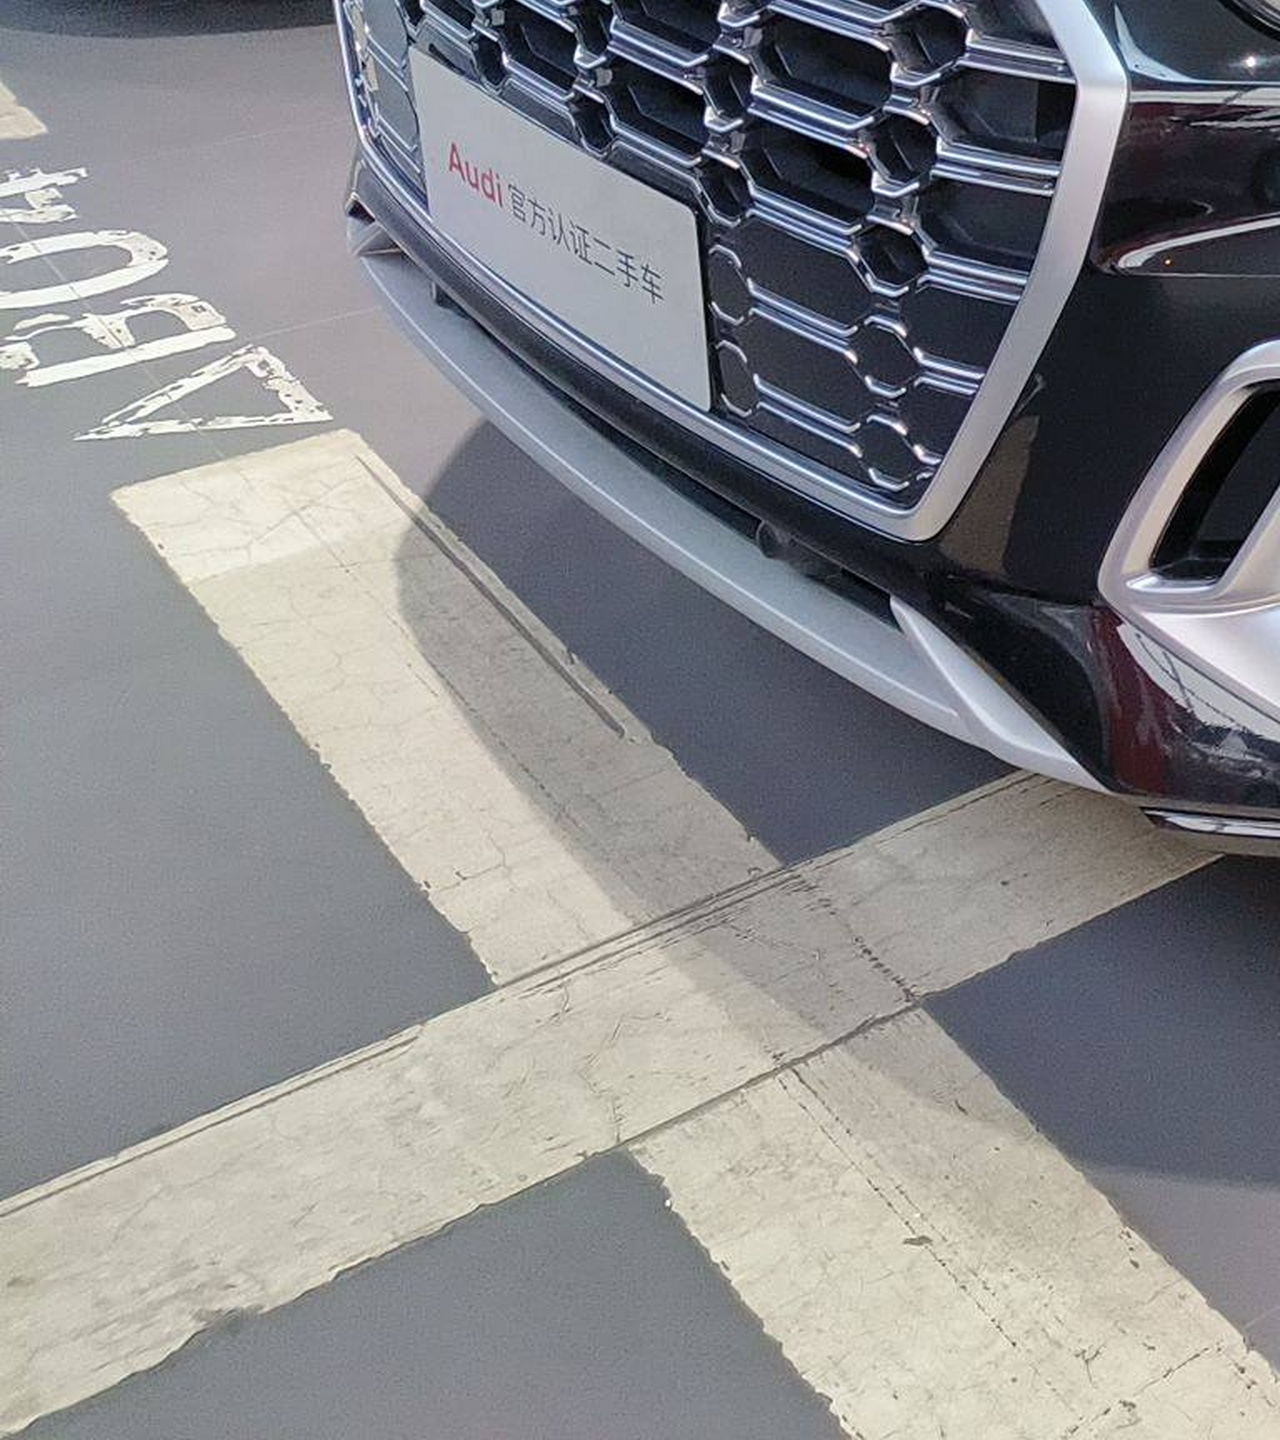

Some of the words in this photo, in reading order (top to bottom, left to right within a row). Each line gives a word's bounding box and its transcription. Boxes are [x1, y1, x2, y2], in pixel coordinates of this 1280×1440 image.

[449, 141, 504, 208] Audi
[507, 182, 665, 305] 官方认证二手车
